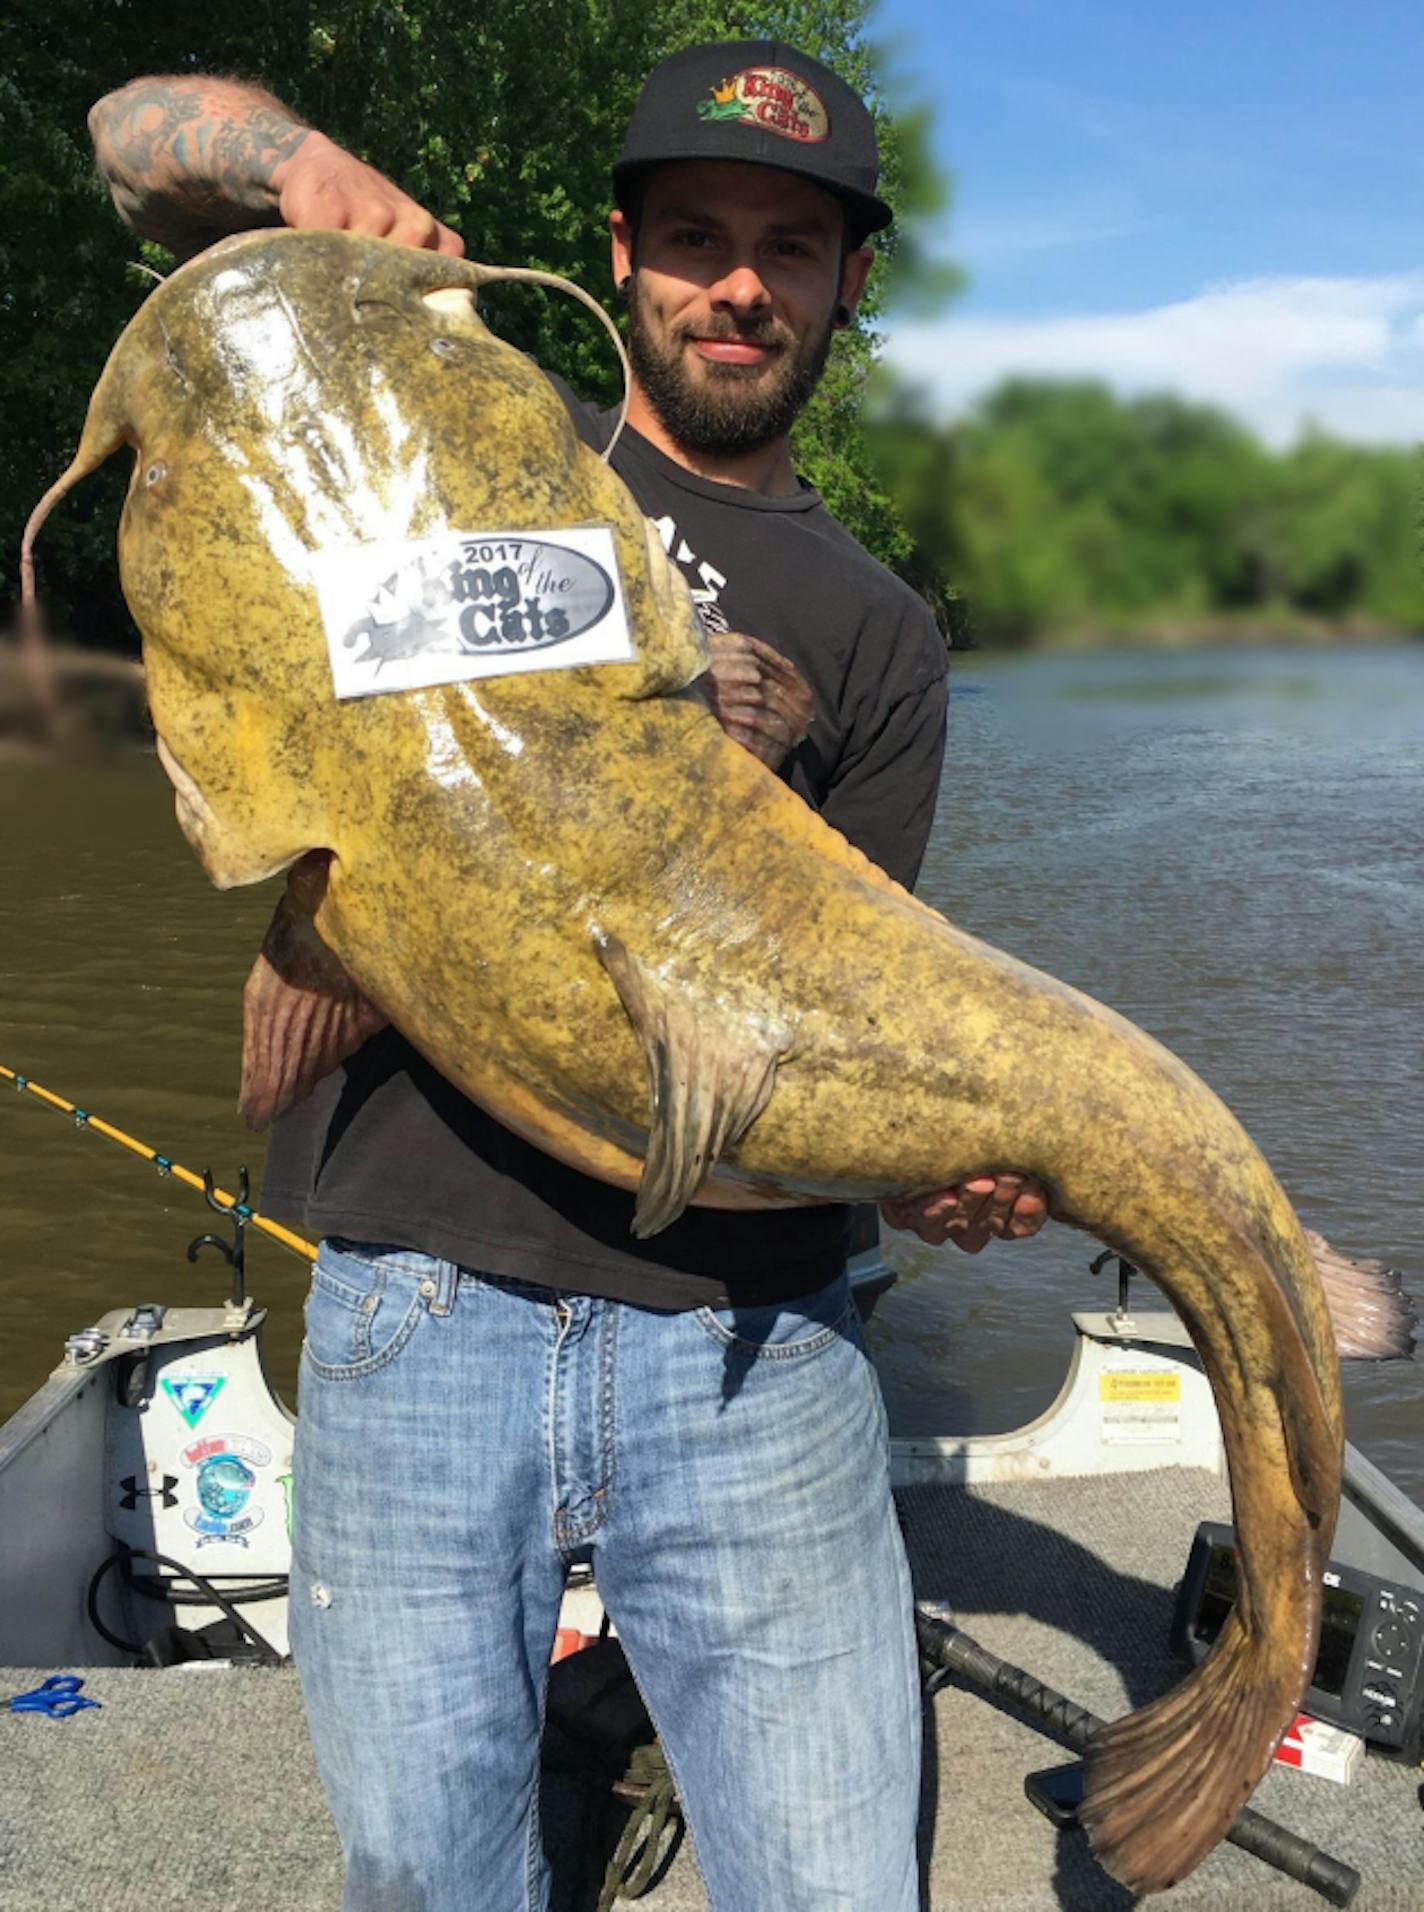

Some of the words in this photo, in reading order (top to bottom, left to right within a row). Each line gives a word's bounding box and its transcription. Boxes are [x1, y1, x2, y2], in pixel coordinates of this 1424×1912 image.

[757, 101, 810, 138] Cats
[464, 544, 523, 563] 2017
[535, 570, 576, 594] the
[459, 597, 570, 646] Cats
